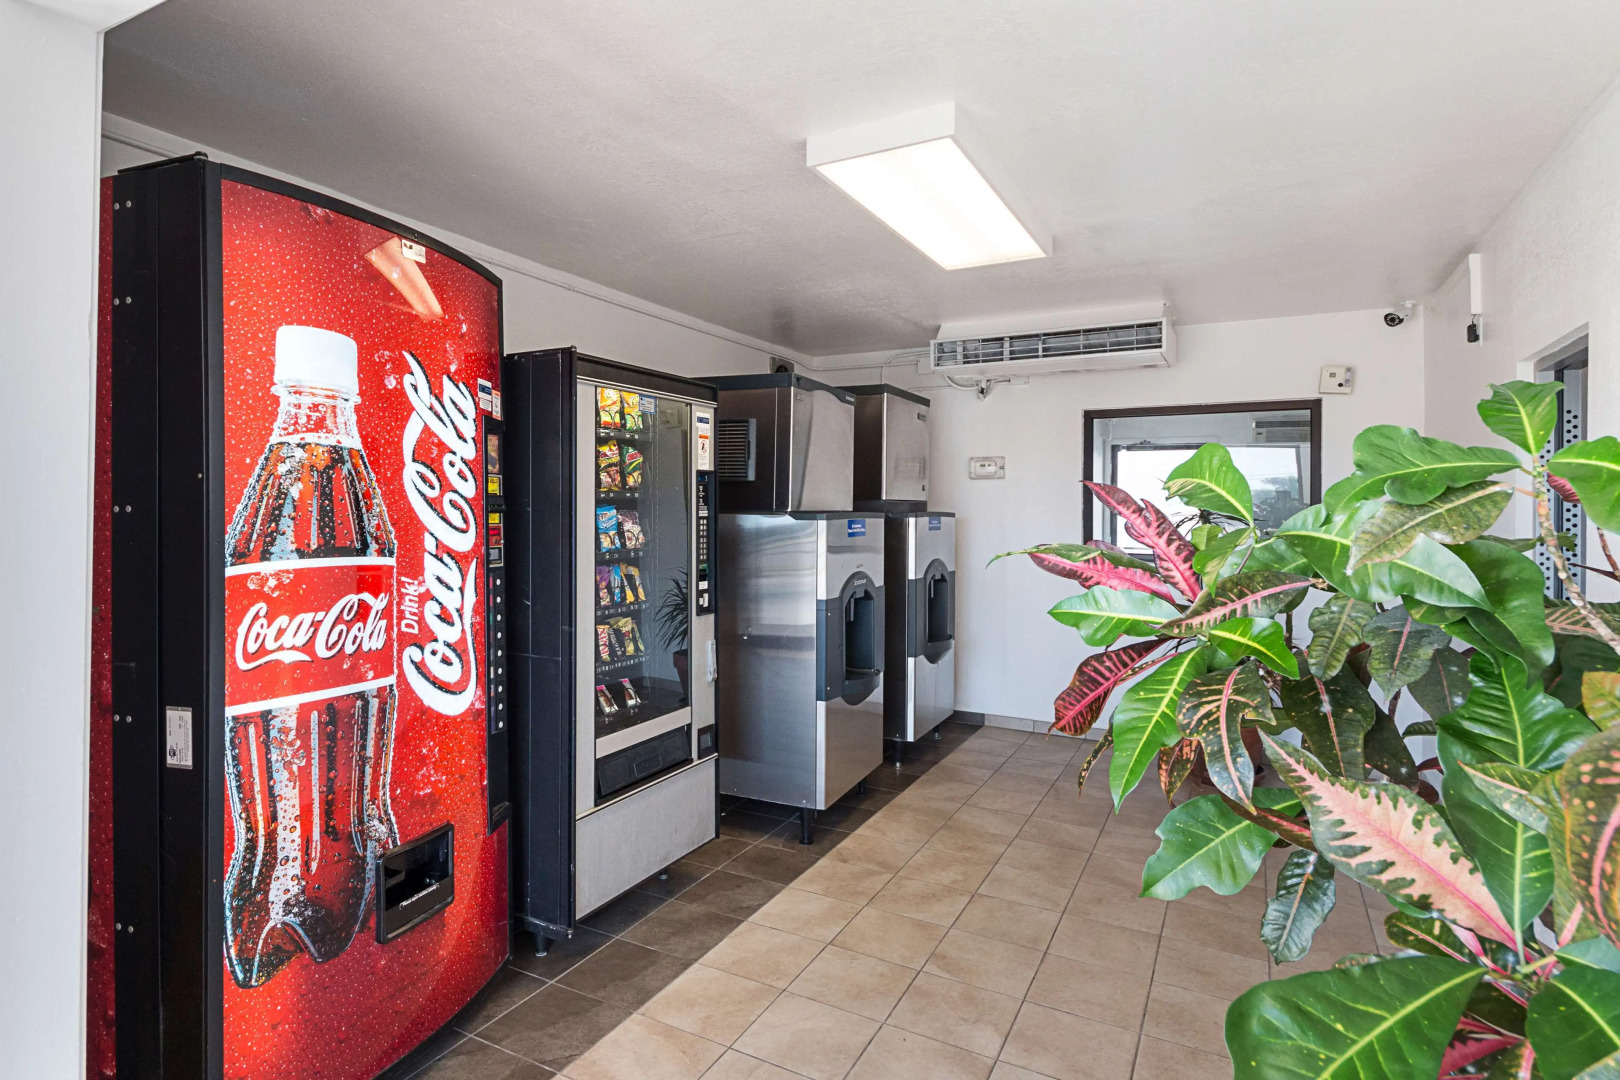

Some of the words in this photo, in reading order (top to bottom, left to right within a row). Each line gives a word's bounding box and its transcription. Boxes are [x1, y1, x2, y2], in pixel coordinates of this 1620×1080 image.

[402, 350, 478, 716] Coca-Cola
[234, 592, 390, 672] Coca-Cola
[400, 576, 419, 635] Drink!
